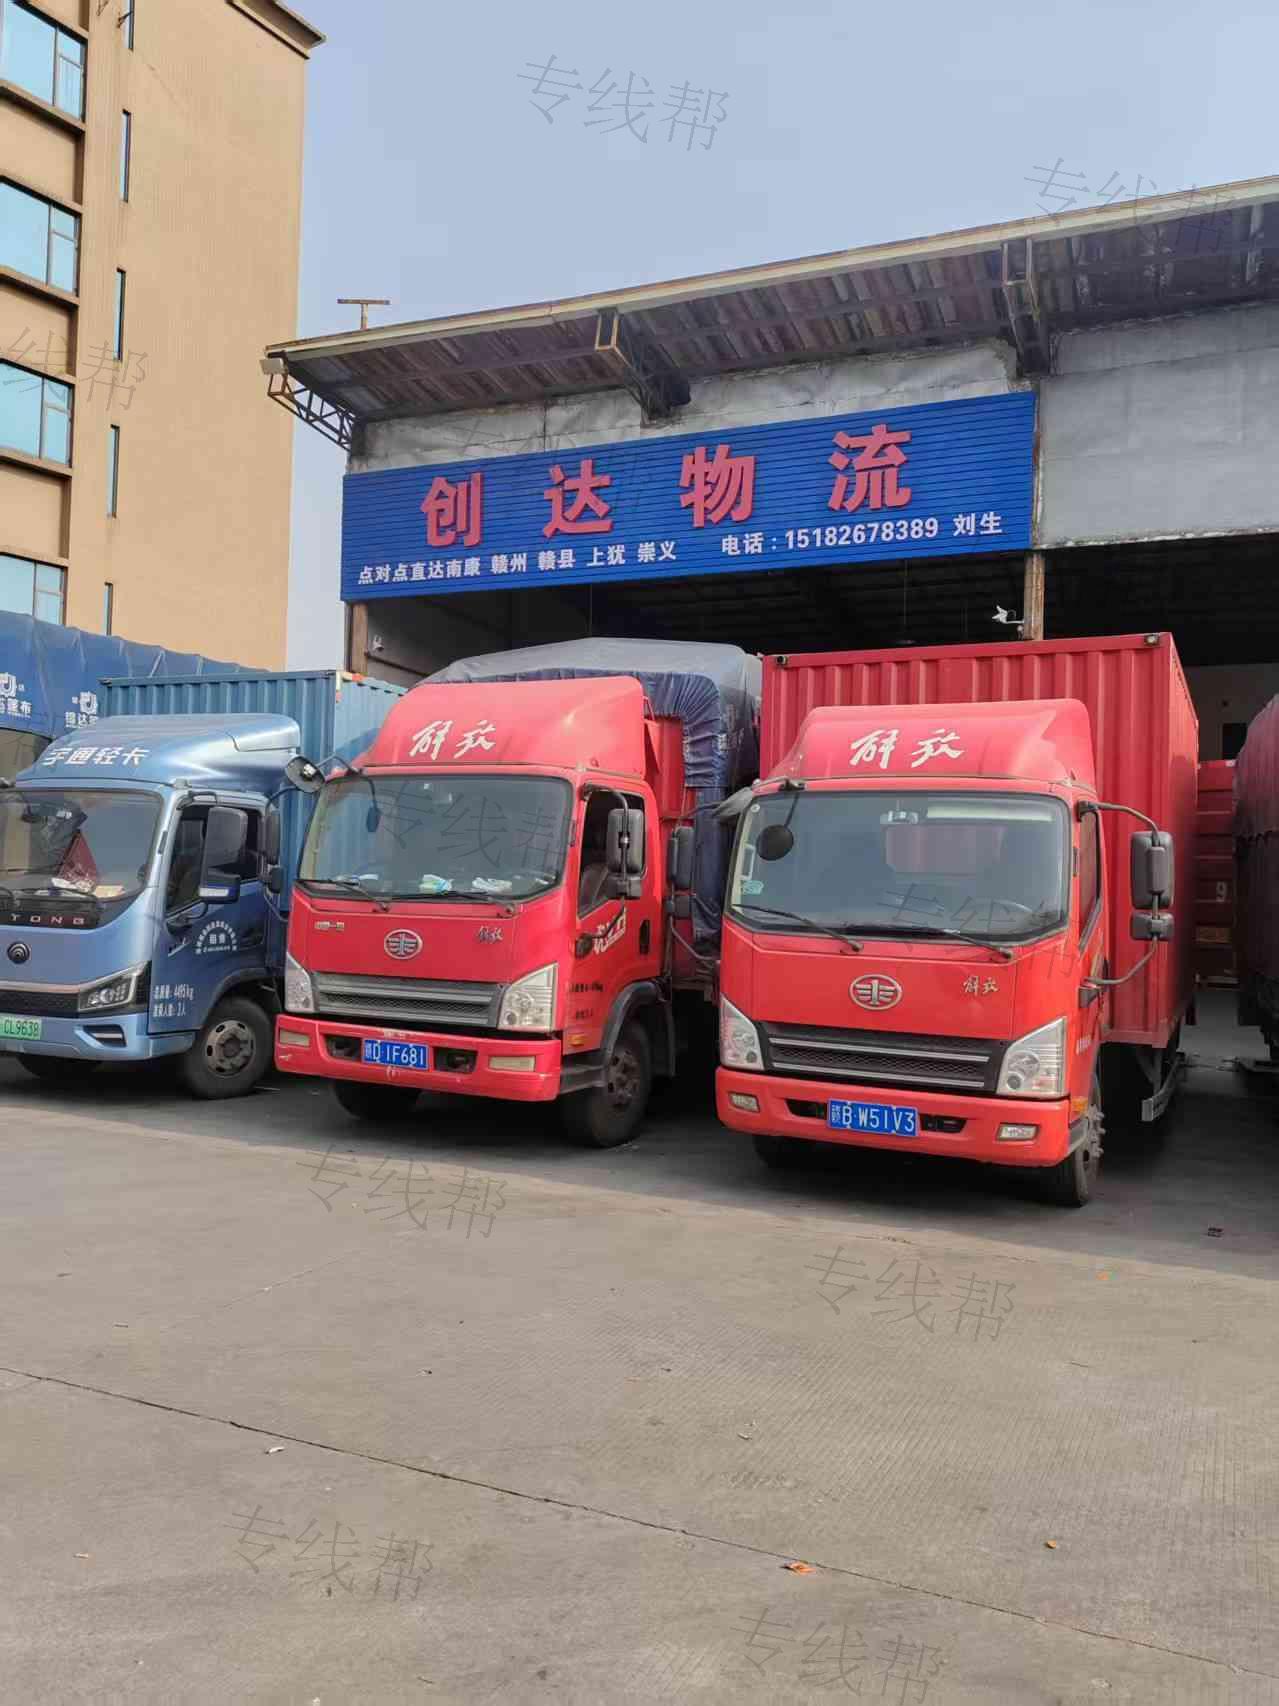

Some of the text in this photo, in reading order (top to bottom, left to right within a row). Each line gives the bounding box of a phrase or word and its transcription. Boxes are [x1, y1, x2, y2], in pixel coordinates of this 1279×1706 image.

[421, 424, 913, 547] 创达物流
[358, 556, 481, 585] 点对点直达南康
[490, 553, 527, 575] 赣州
[537, 548, 577, 572] 赣县
[587, 544, 626, 567] 上犹
[637, 539, 677, 562] 崇义
[953, 512, 1003, 536] 刘生
[42, 747, 150, 766] 宇通轻卡
[409, 719, 497, 759] 解放
[850, 728, 964, 768] 解放
[962, 975, 999, 995] 解放
